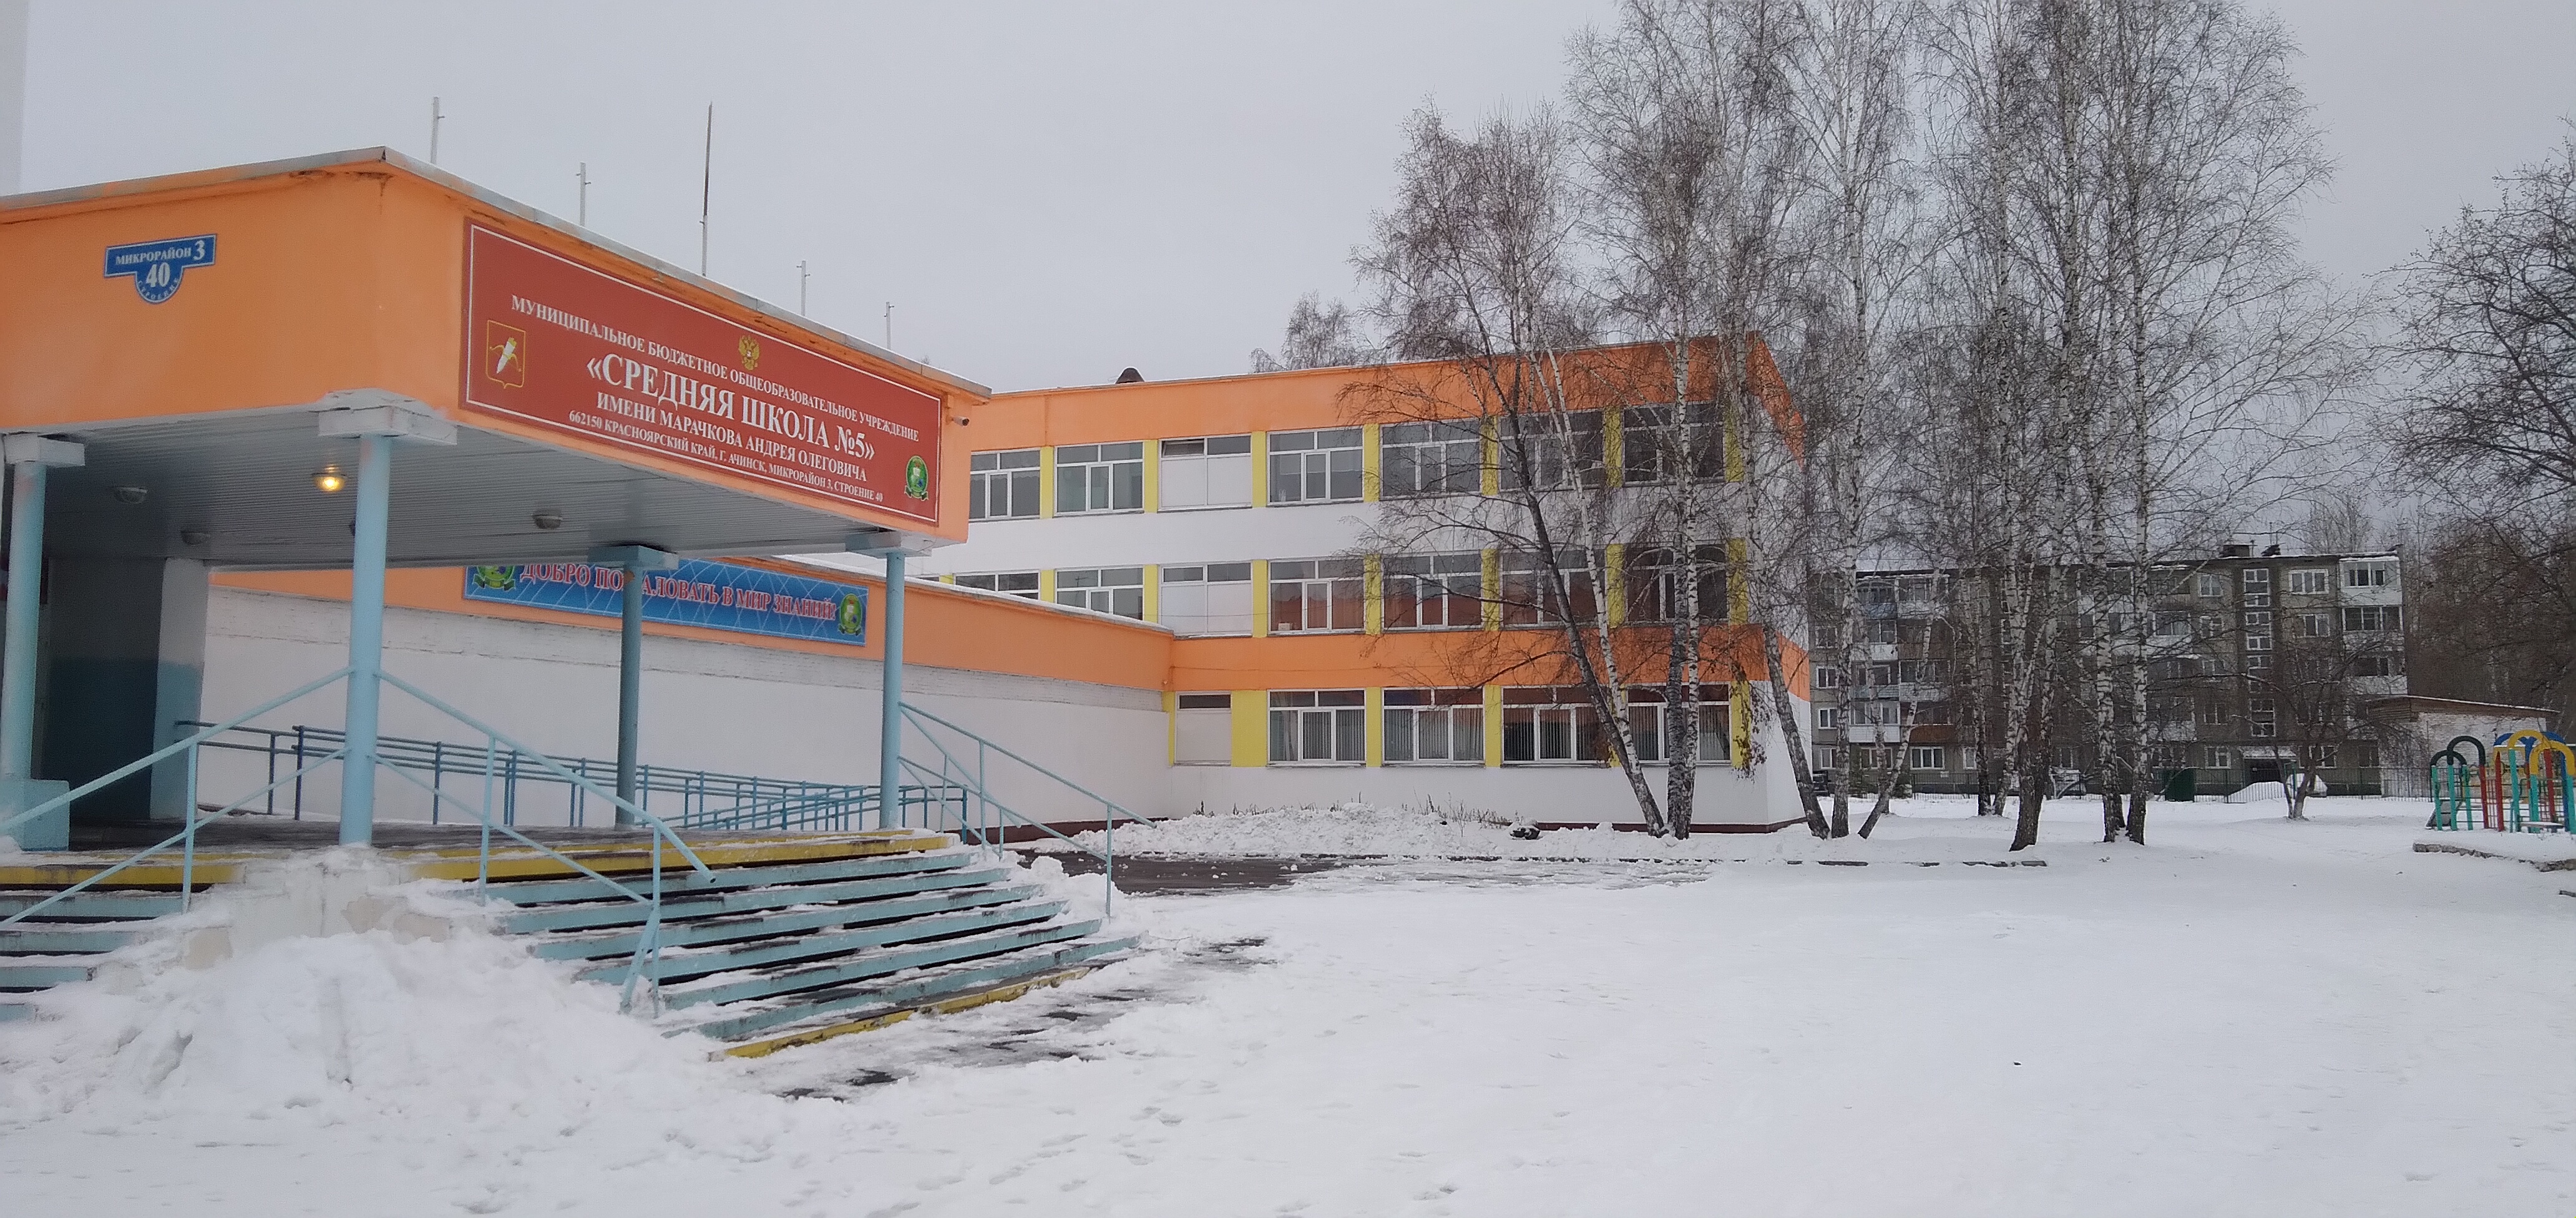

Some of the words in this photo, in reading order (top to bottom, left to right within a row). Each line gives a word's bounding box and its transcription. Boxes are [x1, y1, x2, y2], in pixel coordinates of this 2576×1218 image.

[115, 247, 191, 265] МИКРОРАЙОН
[193, 240, 205, 260] 3
[145, 262, 170, 288] 40
[511, 295, 645, 353] МУНИЦИПАЛЬНОЕ
[648, 341, 728, 379] БЮДЖЕТНОЕ
[730, 368, 857, 422] ОБЩЕОБРАЗОВАТЕЛЬНОЕ
[859, 411, 919, 442] УЧРЕЖДЕНИЕ
[587, 353, 735, 420] «СРЕДНЯЯ
[741, 395, 830, 449] ШКОЛА
[834, 425, 875, 460] №5»
[569, 410, 602, 429] 662150
[604, 420, 689, 452] КРАСНОЯРСКИЙ
[691, 442, 717, 461] КРАЙ,
[720, 451, 727, 462] Г.
[728, 453, 768, 473] АЧИНСК,
[768, 463, 826, 487] МИКРОРАЙОН
[827, 479, 834, 491] 3,
[834, 481, 874, 500] СТРОЕНИЕ
[876, 492, 884, 502] 40
[597, 391, 656, 424] ИМЕНИ
[660, 409, 743, 448] МАРАЧКОВА
[746, 435, 796, 462] АНДРЕЯ
[798, 450, 867, 482] ОЛЕГОВИЧА
[520, 563, 591, 586] ДОБРО
[595, 566, 719, 605] ПОАЛОВАТЬ
[723, 587, 733, 606] В
[736, 588, 771, 611] МИР
[773, 593, 837, 620] ЗНАНИЙ!
